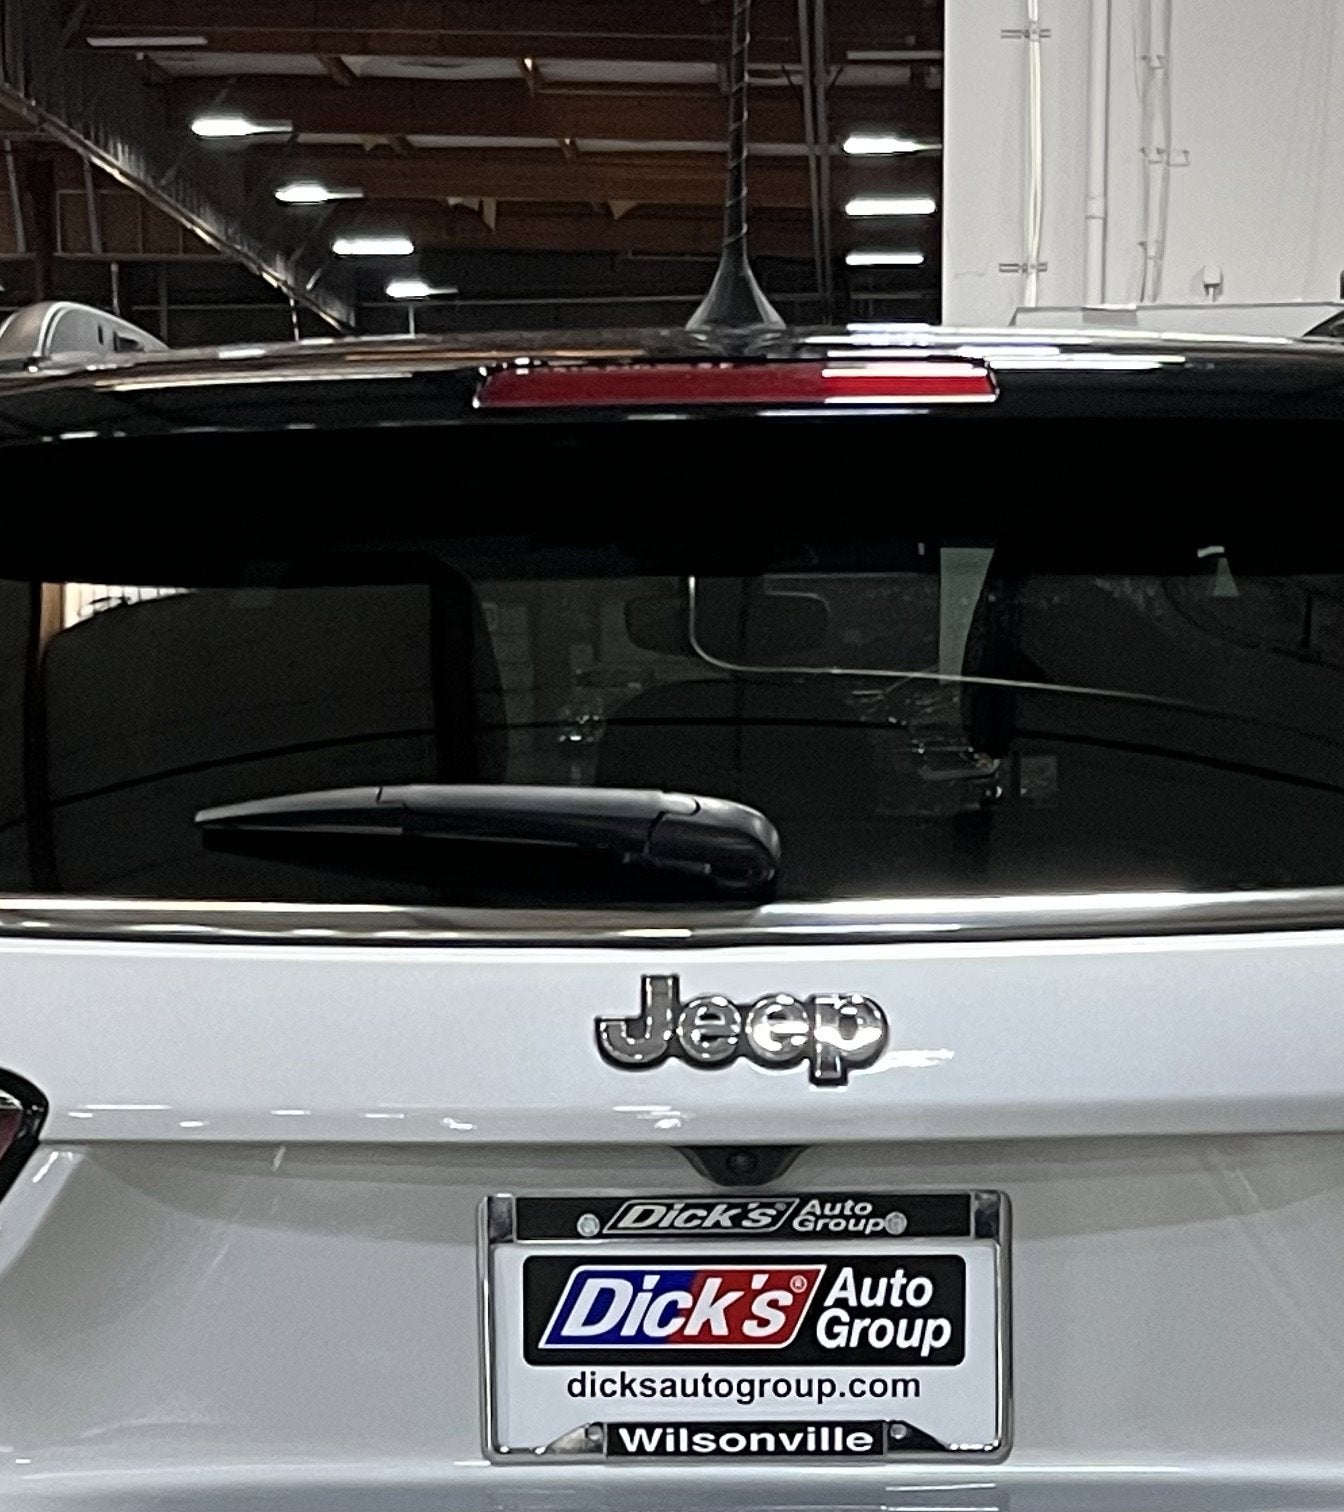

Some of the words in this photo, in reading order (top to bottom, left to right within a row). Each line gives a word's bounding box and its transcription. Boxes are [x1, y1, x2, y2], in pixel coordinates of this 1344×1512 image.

[594, 973, 889, 1086] Jeep
[617, 1201, 778, 1229] Dick's
[797, 1199, 873, 1216] Auto
[792, 1216, 887, 1235] Group
[823, 1267, 934, 1308] Auto
[560, 1273, 794, 1338] Dick's
[816, 1308, 952, 1357] Group
[567, 1371, 921, 1404] dicksautogroup.com
[617, 1426, 874, 1453] Wilsonville
